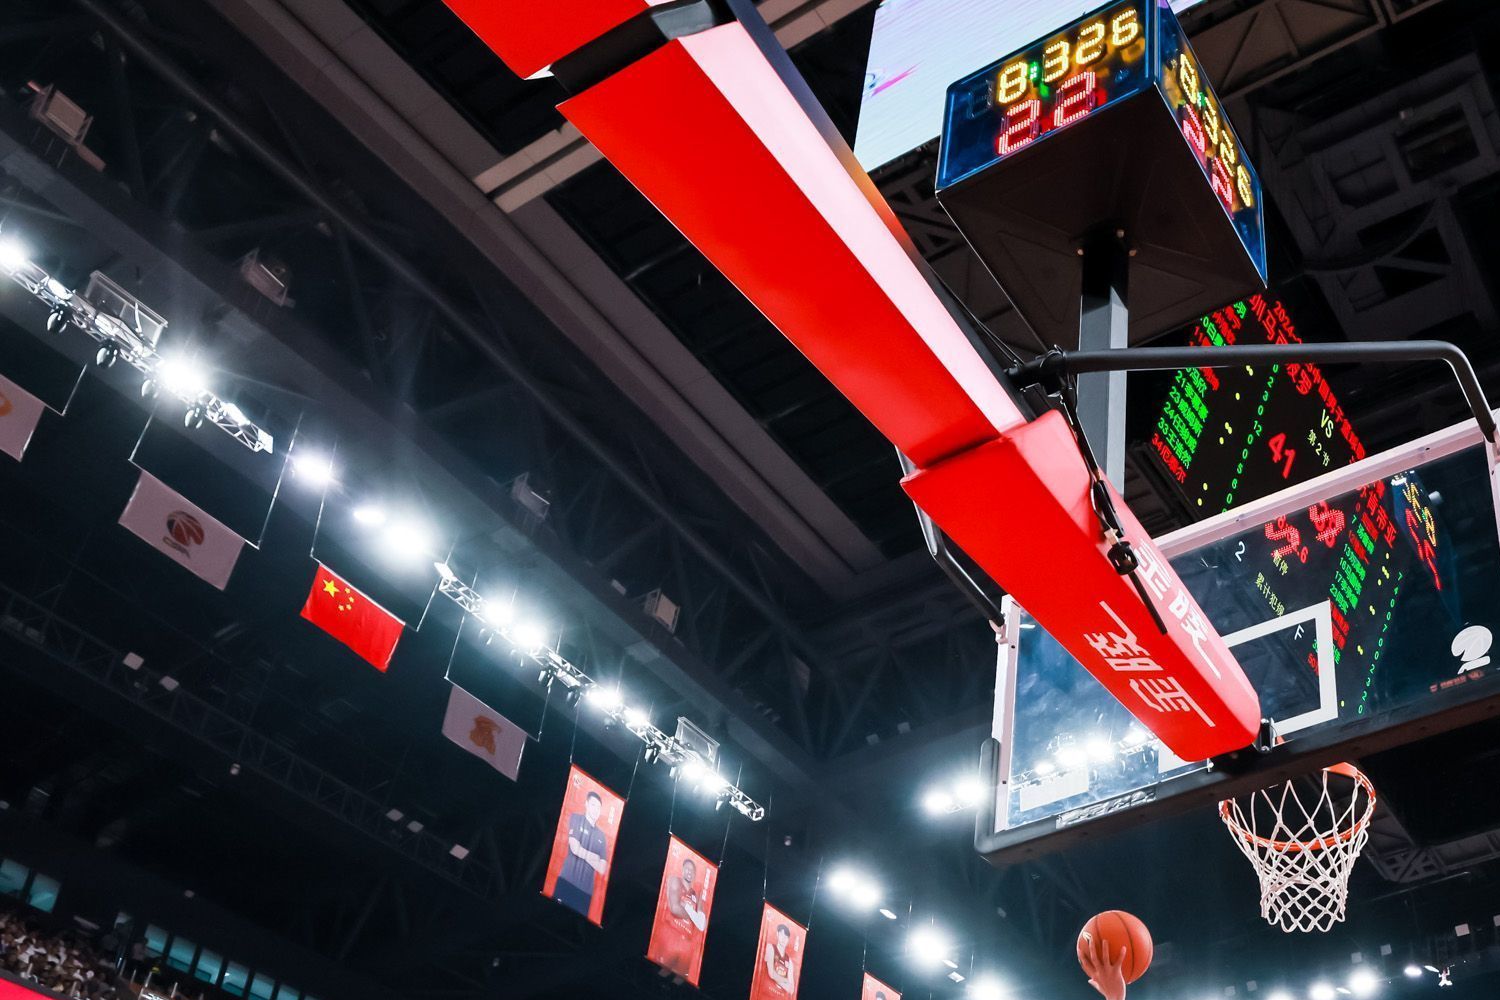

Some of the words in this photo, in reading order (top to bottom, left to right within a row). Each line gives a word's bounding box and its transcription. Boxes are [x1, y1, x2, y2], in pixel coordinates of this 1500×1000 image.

[998, 71, 1096, 155] 22
[1320, 409, 1334, 438] VS
[1268, 433, 1296, 479] 41
[1235, 541, 1247, 561] 2
[1294, 624, 1305, 641] F
